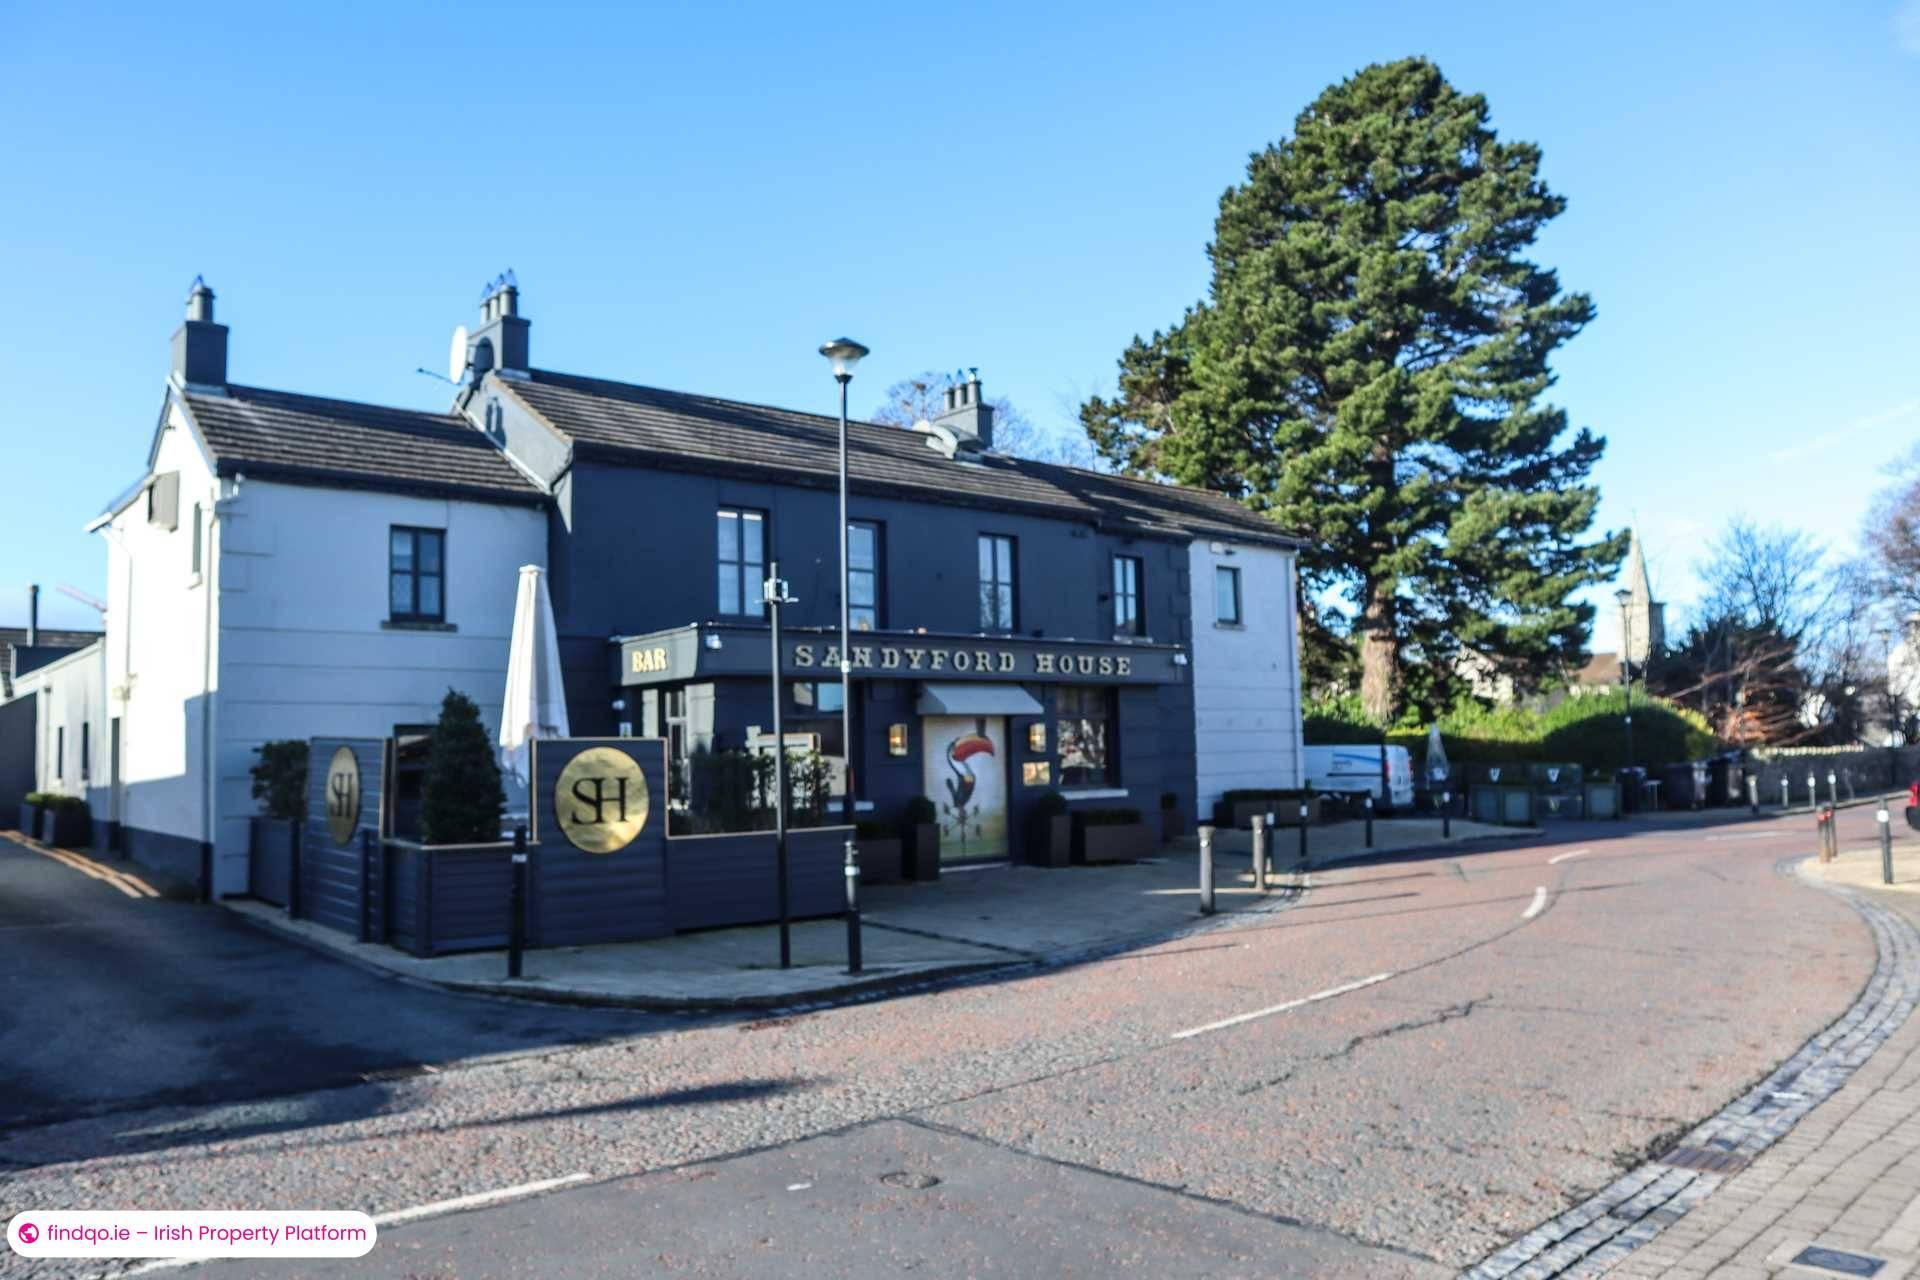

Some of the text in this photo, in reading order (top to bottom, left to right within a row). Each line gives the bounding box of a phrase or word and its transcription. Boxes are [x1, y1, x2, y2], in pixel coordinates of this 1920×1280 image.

[632, 648, 668, 673] BAR
[795, 645, 1132, 676] SANDYFORD HOUSE
[331, 773, 354, 818] SH
[571, 776, 630, 826] SH
